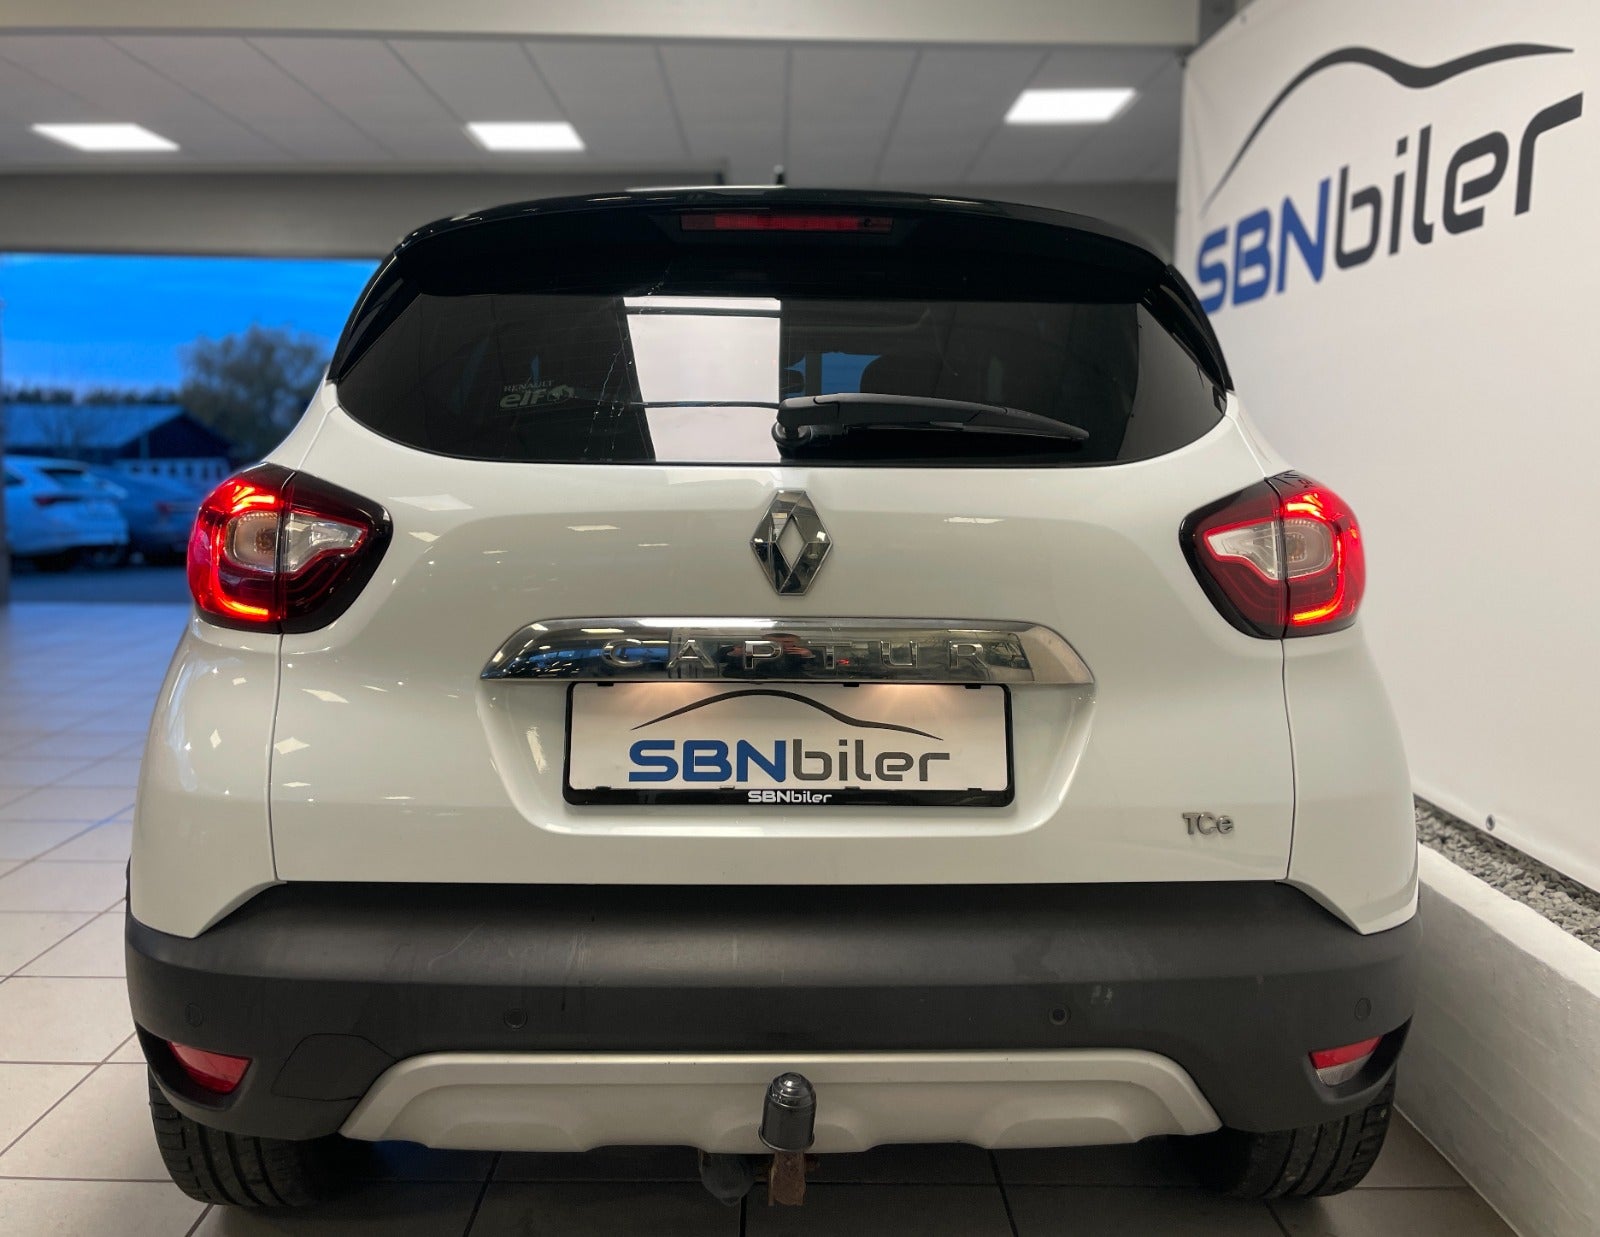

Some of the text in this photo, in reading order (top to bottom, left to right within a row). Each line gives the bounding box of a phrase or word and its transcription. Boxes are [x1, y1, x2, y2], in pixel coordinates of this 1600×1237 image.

[1196, 91, 1583, 316] SBNbiler
[503, 380, 554, 393] RENAULT
[602, 638, 991, 671] CAPTUR
[628, 738, 951, 783] SBNbiler
[747, 789, 833, 804] SBNbiler
[1182, 811, 1234, 835] TCe
